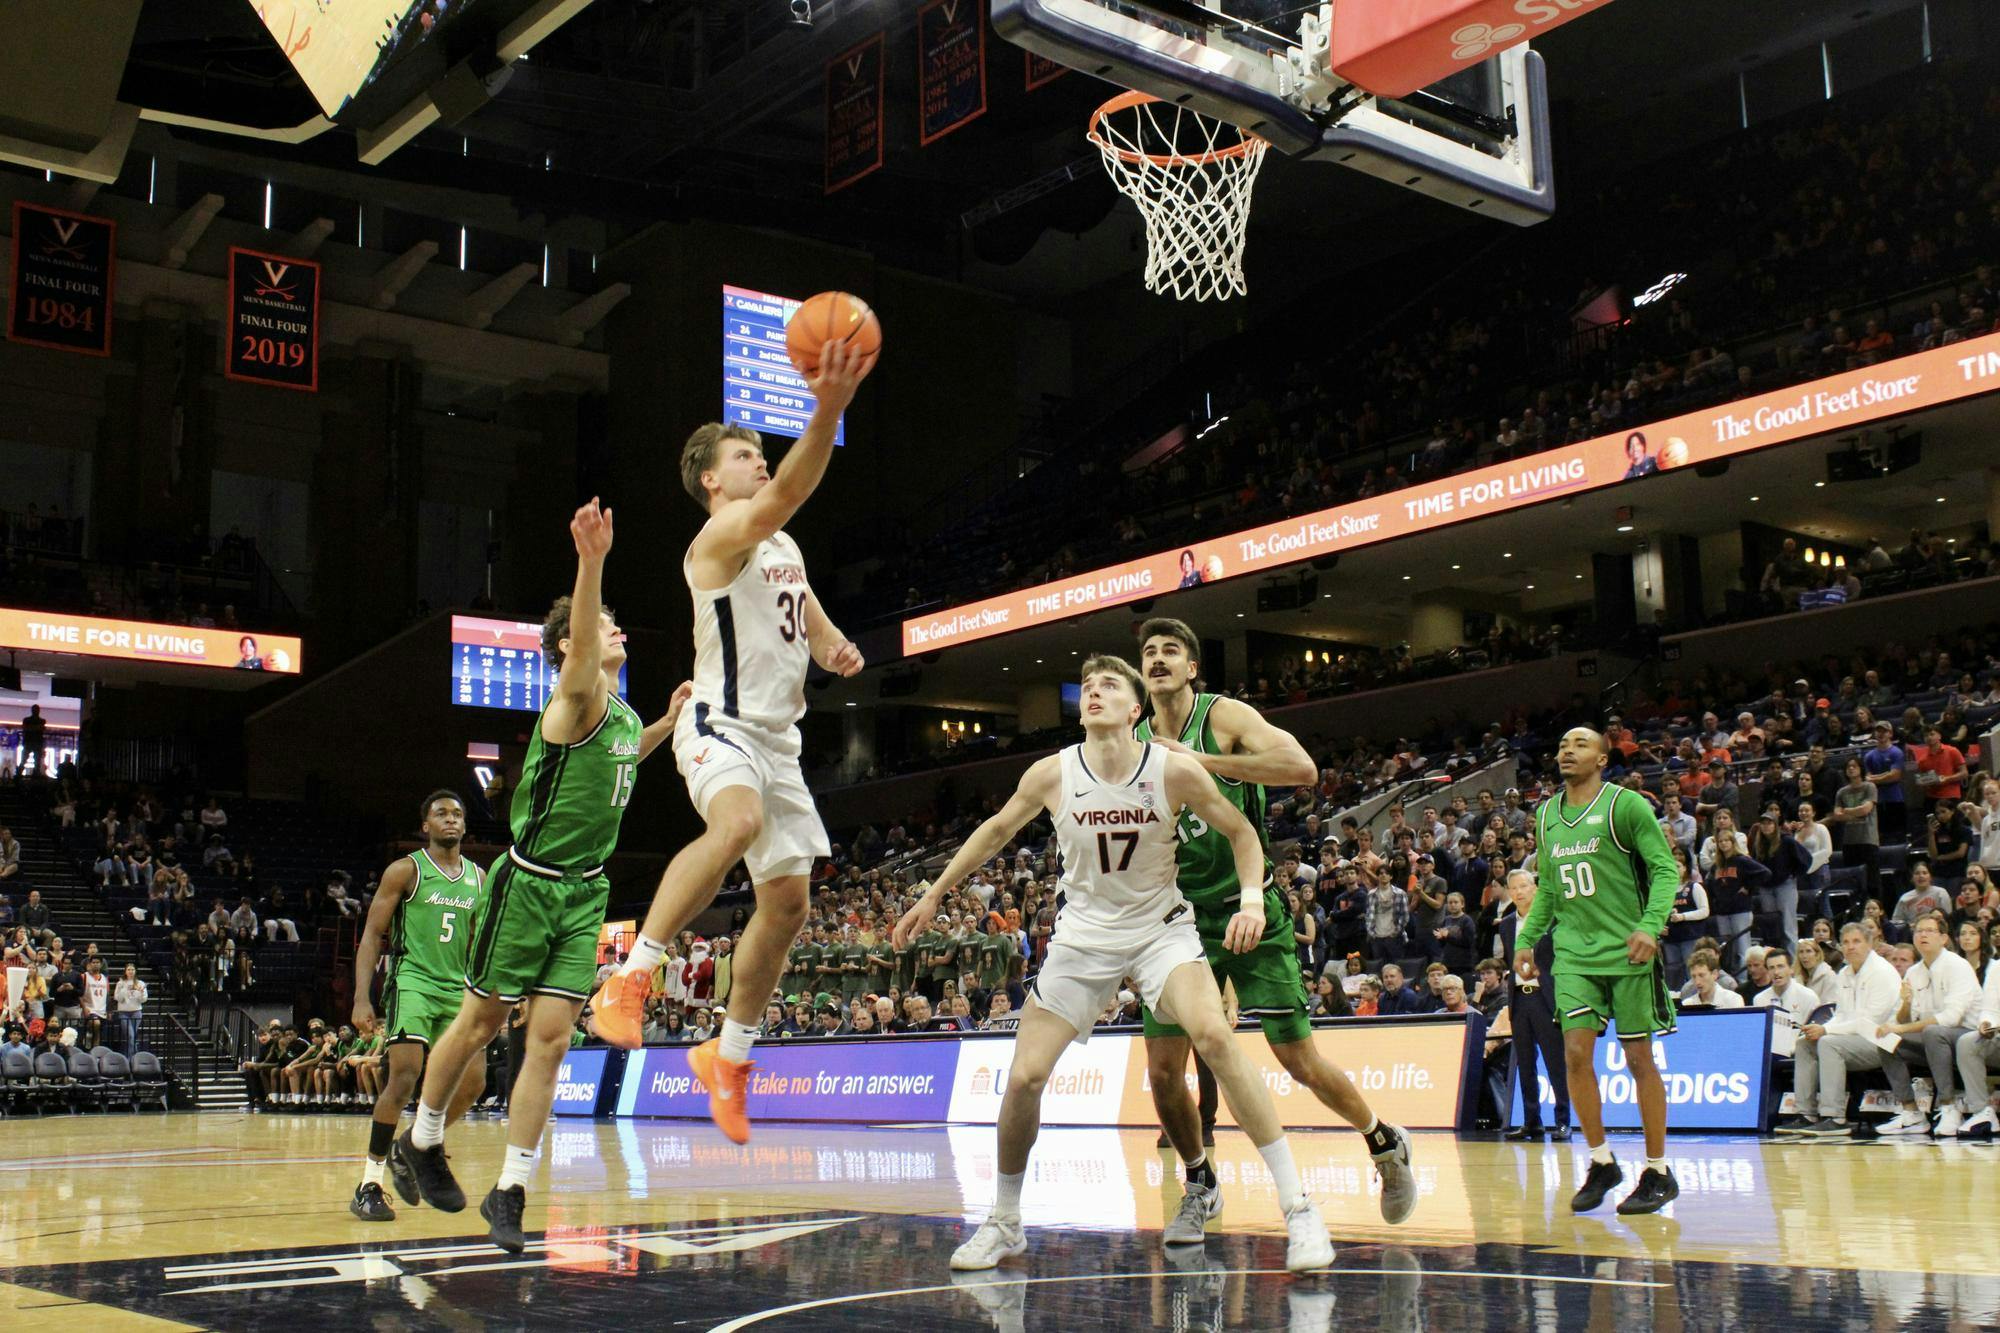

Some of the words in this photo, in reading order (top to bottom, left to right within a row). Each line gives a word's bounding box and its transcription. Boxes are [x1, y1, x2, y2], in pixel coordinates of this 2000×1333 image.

[25, 272, 62, 289] FINAL
[66, 280, 100, 296] FOUR
[26, 296, 94, 332] 1984
[264, 299, 307, 312] BASKETBALL
[736, 300, 783, 317] CAVALIERS
[784, 299, 803, 309] STAT
[240, 313, 274, 329] FINAL
[276, 320, 308, 334] FOUR
[241, 335, 305, 368] 2019
[759, 350, 771, 361] 2nd
[741, 367, 751, 378] 14
[759, 371, 775, 382] FAST
[775, 374, 797, 386] BREAK
[797, 378, 809, 389] PTS
[765, 394, 777, 403] PTS
[779, 396, 793, 407] OFF
[794, 399, 804, 409] TO
[1712, 414, 1751, 442] The
[1754, 396, 1810, 432] Good
[1815, 386, 1860, 419] Feet
[1861, 376, 1920, 406] Store
[765, 415, 789, 427] BENCH
[790, 419, 804, 430] PTS
[1404, 491, 1454, 520] TIME
[1458, 479, 1505, 507] FOR
[1509, 458, 1586, 495] LIVING
[1240, 539, 1266, 562] The
[1268, 525, 1306, 555] Good
[1308, 521, 1340, 545] Feet
[1341, 513, 1379, 537] Store
[761, 567, 805, 584] VIRGIN
[1026, 593, 1061, 616] TIME
[1065, 583, 1096, 607] FOR
[1099, 569, 1153, 598] LIVING
[777, 591, 807, 643] 30
[910, 625, 929, 646] The
[929, 617, 957, 641] Good
[959, 612, 981, 634] Feet
[981, 608, 1009, 629] Store
[27, 622, 80, 645] TIME
[86, 628, 131, 649] FOR
[134, 634, 206, 655] LIVING
[525, 662, 532, 671] 2
[525, 671, 532, 680] 0
[504, 688, 511, 697] 3
[525, 681, 532, 690] 2
[608, 736, 641, 755] Marsha
[610, 763, 633, 807] 15
[1072, 809, 1160, 826] VIRGINIA
[1097, 831, 1139, 874] 17
[1550, 837, 1600, 858] Marshall
[1559, 861, 1597, 899] 50
[425, 891, 475, 910] Marshall
[439, 912, 456, 943] 5
[1606, 1040, 1668, 1071] UA
[557, 1064, 572, 1081] VA
[1361, 1068, 1386, 1090] to
[1390, 1064, 1434, 1090] life.
[554, 1082, 595, 1101] PEDICS
[652, 1072, 690, 1098] Hope
[752, 1072, 786, 1095] take
[790, 1076, 812, 1095] no
[815, 1070, 840, 1095] for
[842, 1075, 863, 1095] an
[866, 1074, 934, 1095] answer.
